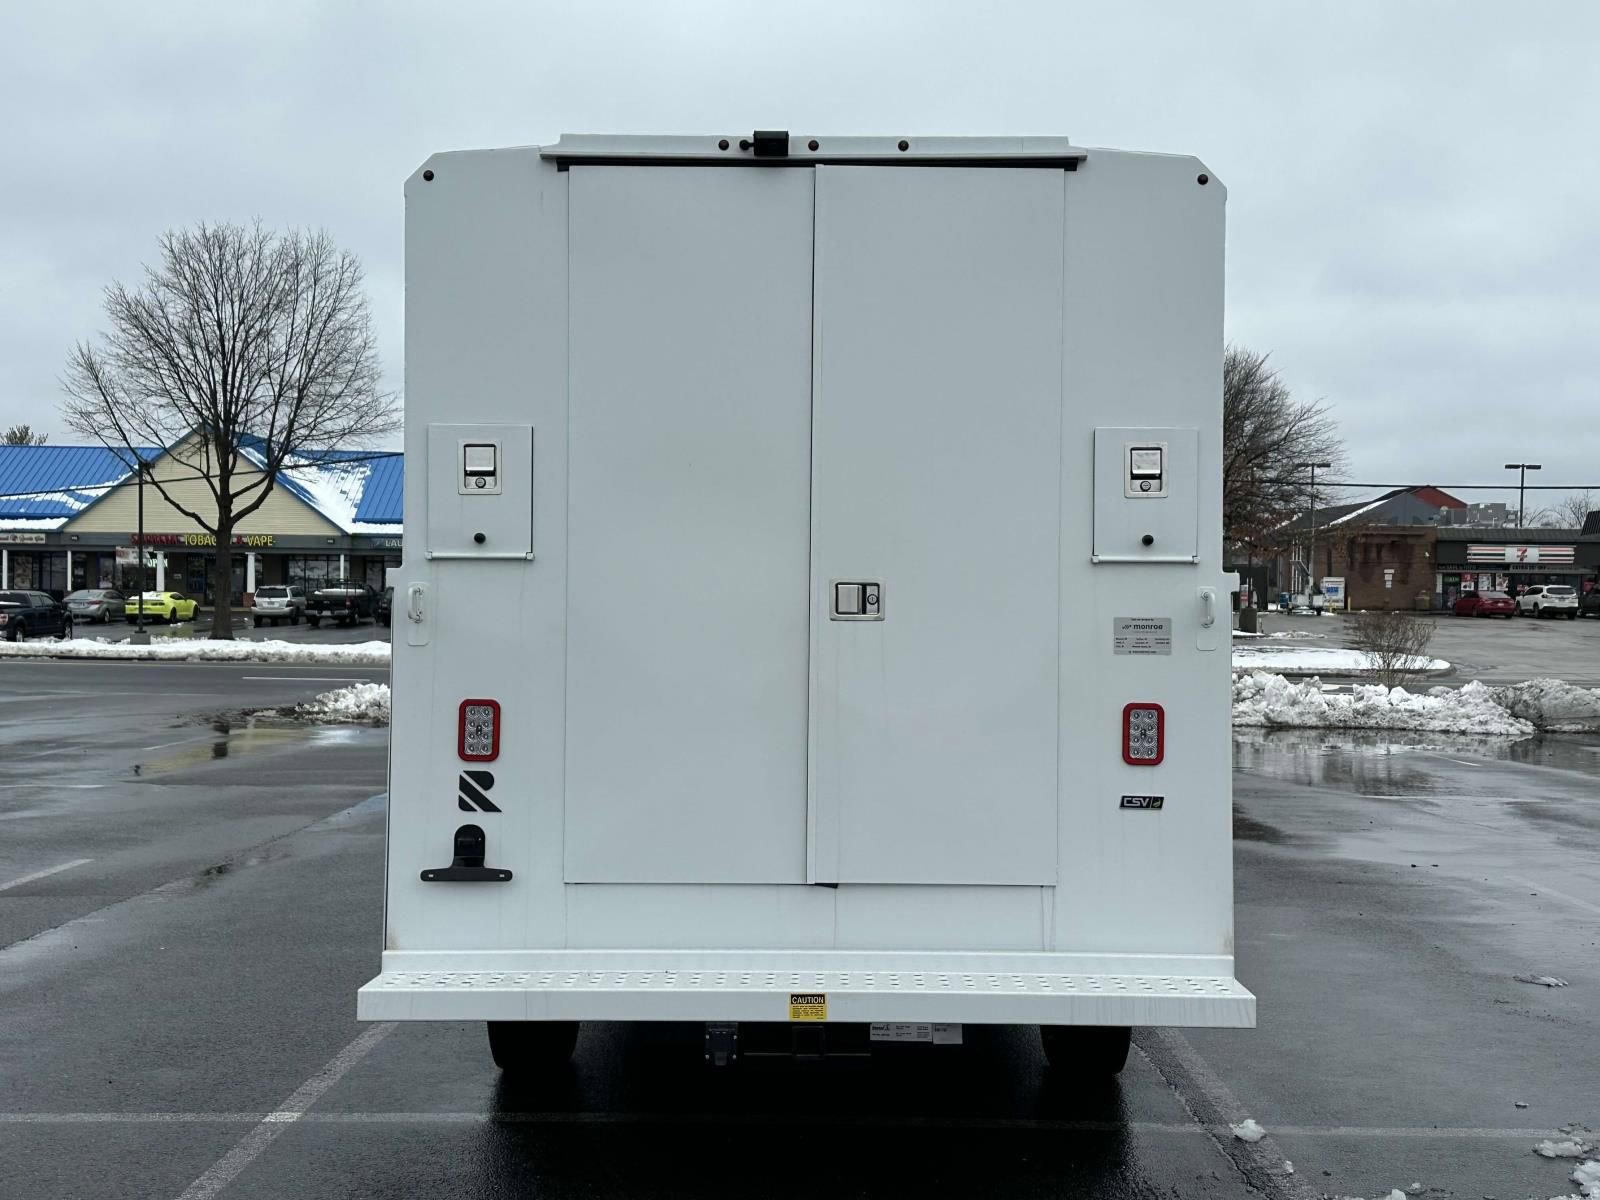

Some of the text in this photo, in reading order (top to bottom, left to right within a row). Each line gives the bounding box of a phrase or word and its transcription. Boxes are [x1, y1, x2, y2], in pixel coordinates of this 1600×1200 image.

[247, 535, 273, 546] VAPE
[147, 558, 168, 568] OPN
[1123, 797, 1150, 807] CSV
[791, 996, 824, 1004] CAUTION
